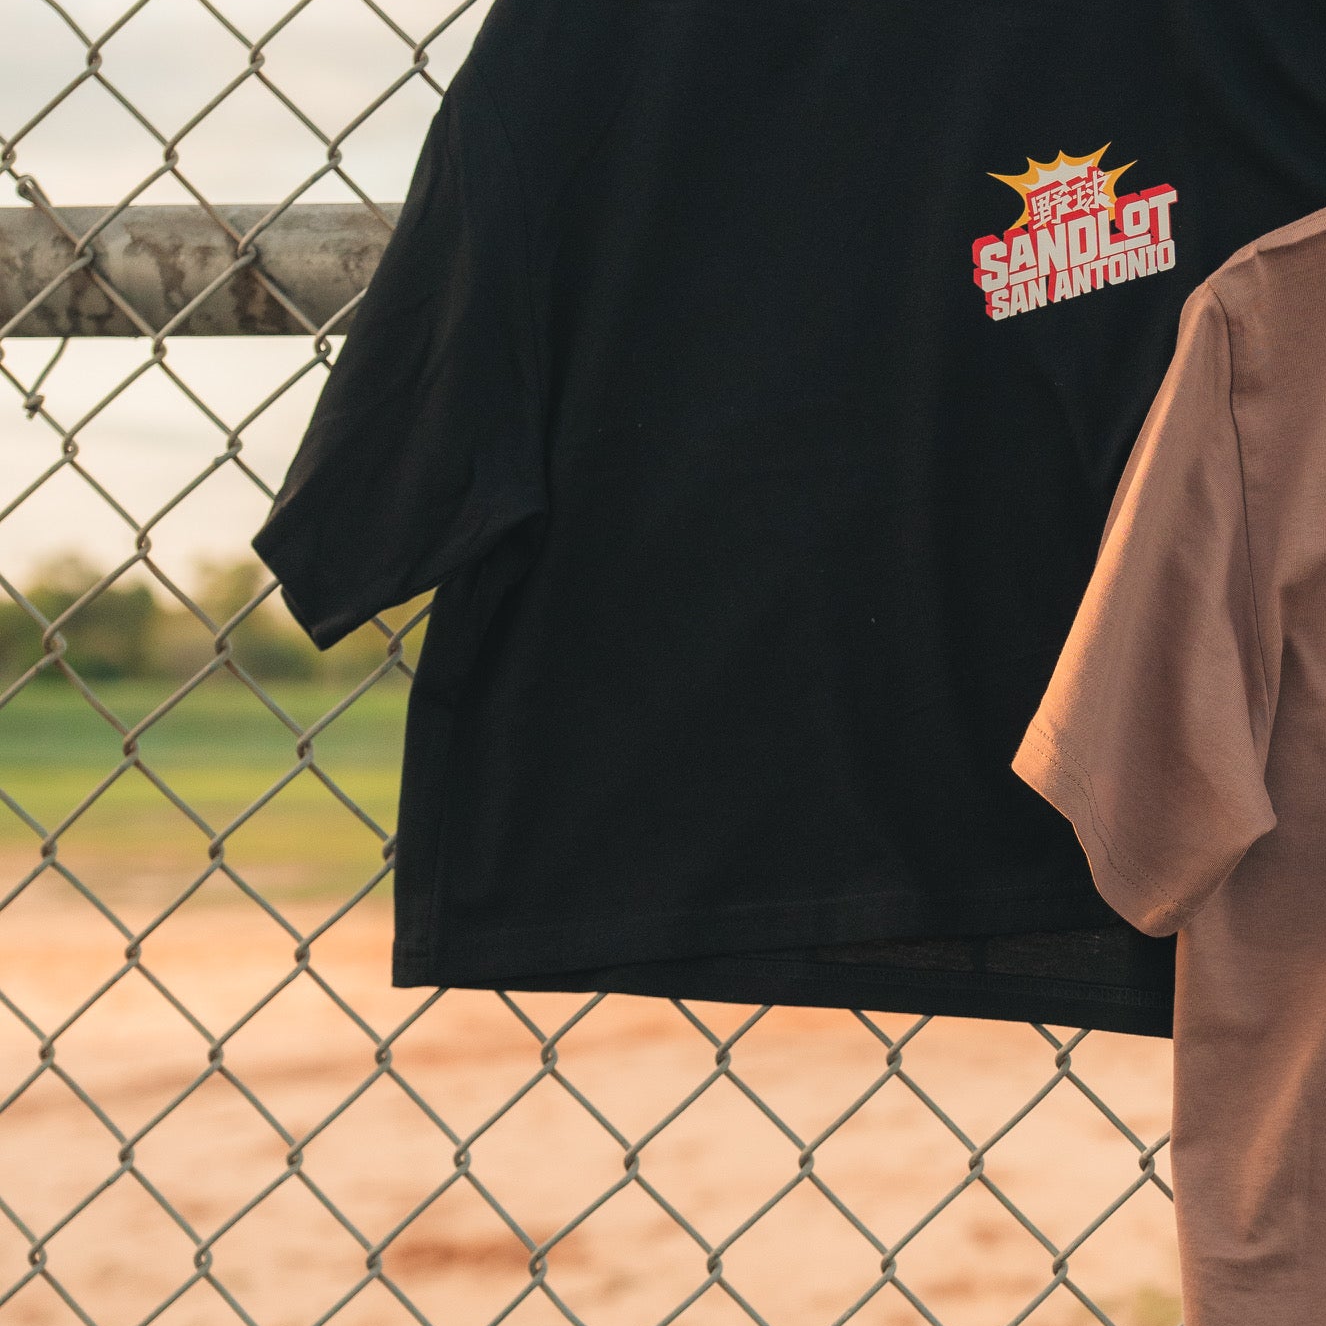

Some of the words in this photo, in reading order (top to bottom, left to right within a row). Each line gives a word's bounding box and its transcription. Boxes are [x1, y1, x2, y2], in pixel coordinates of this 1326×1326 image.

[1031, 170, 1114, 229] 野球
[979, 189, 1177, 293] SANDLOT
[991, 276, 1048, 321] SAN
[1053, 239, 1176, 303] ANTONIO
